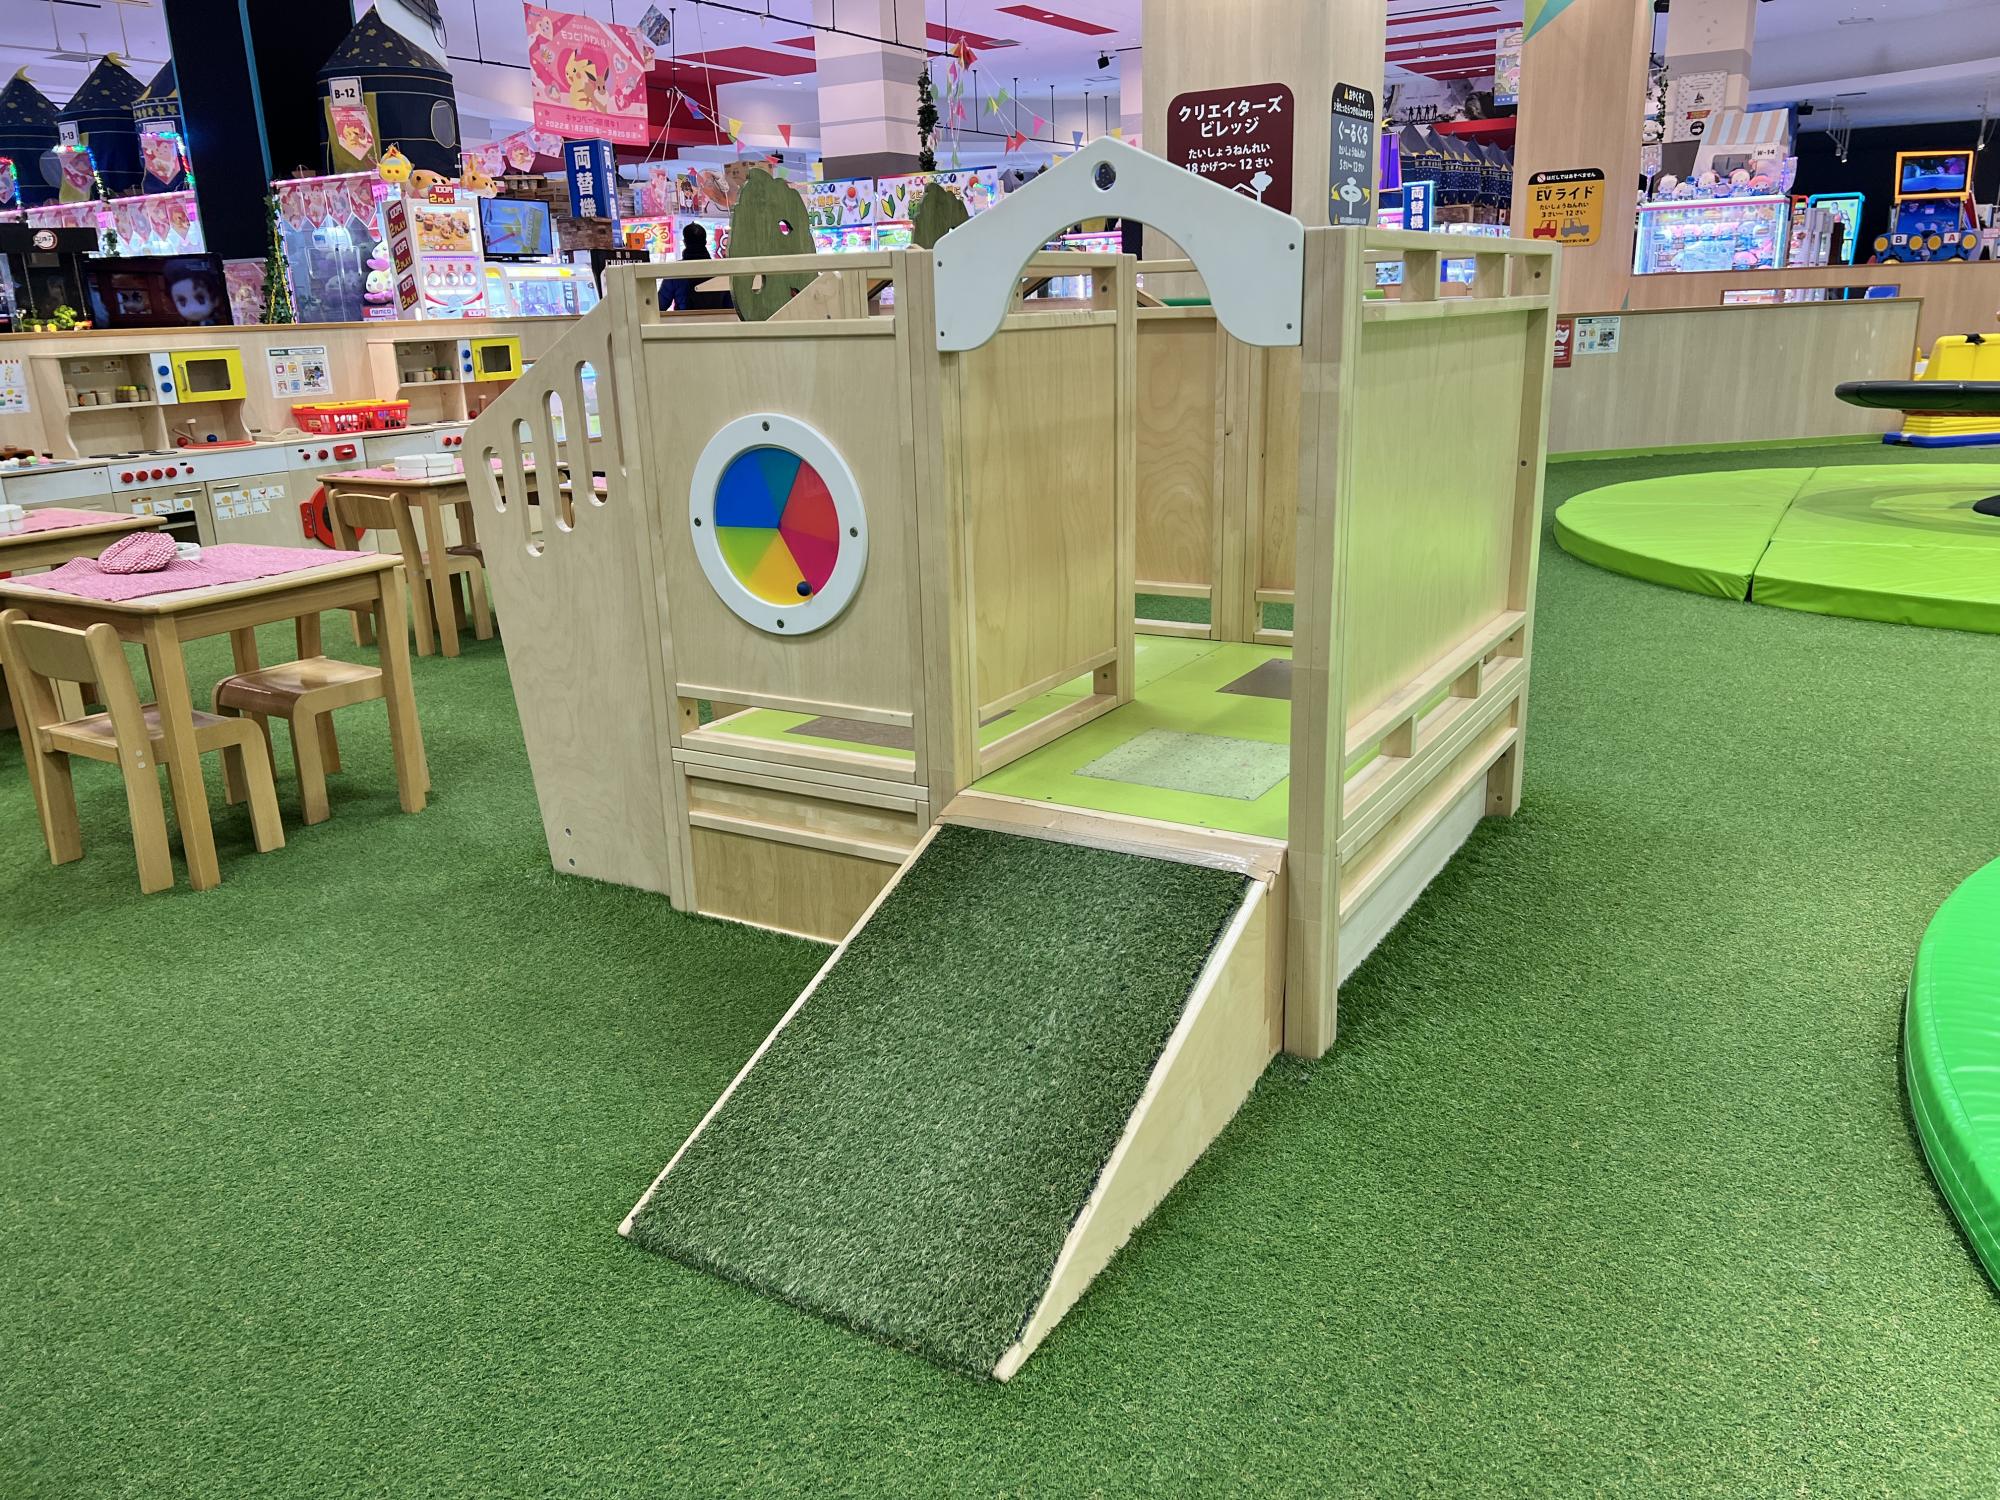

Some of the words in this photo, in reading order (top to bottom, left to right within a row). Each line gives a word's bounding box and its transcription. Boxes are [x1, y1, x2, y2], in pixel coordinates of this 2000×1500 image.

[334, 88, 356, 99] B-12
[1178, 95, 1283, 122] クリエイターズ
[1201, 116, 1260, 138] ビレッジ
[1338, 120, 1368, 145] ぐーるぐる
[1188, 143, 1271, 159] たいしょうねんれい
[573, 145, 597, 218] 両替機
[1536, 189, 1552, 202] EV
[1555, 185, 1595, 201] ライド
[1411, 186, 1424, 229] 両替機
[1539, 202, 1589, 210] たいしょうねんれい
[1895, 236, 1903, 244] B
[1948, 234, 1955, 242] A
